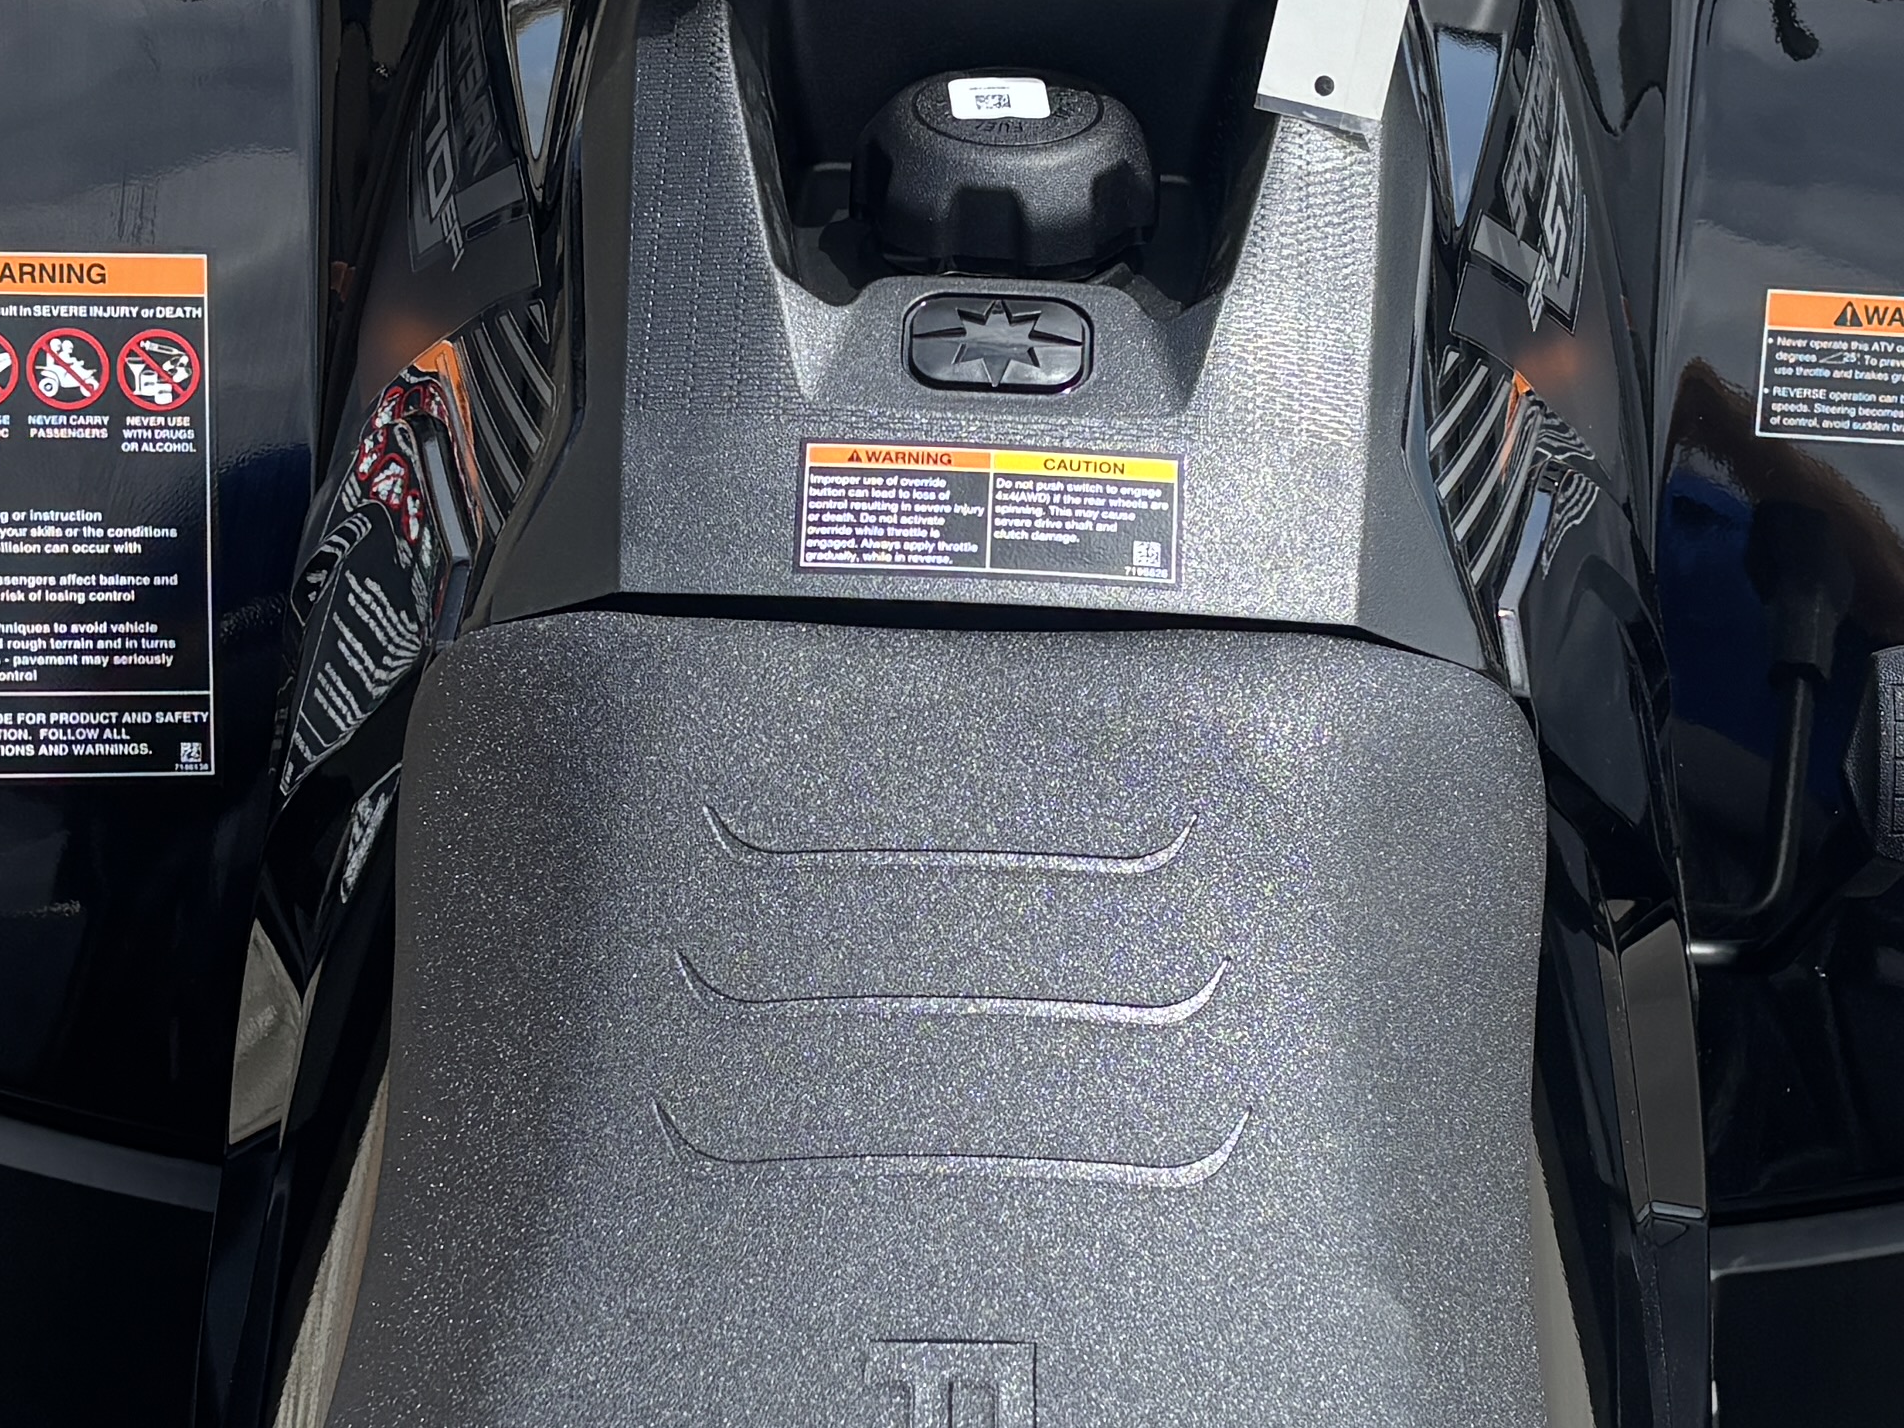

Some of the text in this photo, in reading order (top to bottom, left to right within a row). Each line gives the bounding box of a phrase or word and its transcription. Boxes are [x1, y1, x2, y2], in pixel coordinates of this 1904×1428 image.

[19, 305, 31, 317] in
[33, 305, 86, 317] SEVERE
[89, 306, 138, 318] INJURY
[141, 306, 154, 318] or
[156, 306, 201, 318] DEATH
[27, 415, 109, 425] NEVER CARRY
[29, 427, 107, 438] PASSENGERS
[866, 449, 952, 467] WARNING
[1043, 458, 1125, 475] CAUTION
[17, 712, 46, 724] FOR
[49, 711, 118, 724] PRODUCT
[122, 711, 151, 723] AND
[155, 710, 208, 723] SAFETY
[39, 727, 98, 740] FOLLOW
[103, 727, 129, 739] ALL
[38, 744, 68, 756] AND
[72, 743, 152, 755] WARNINGS.
